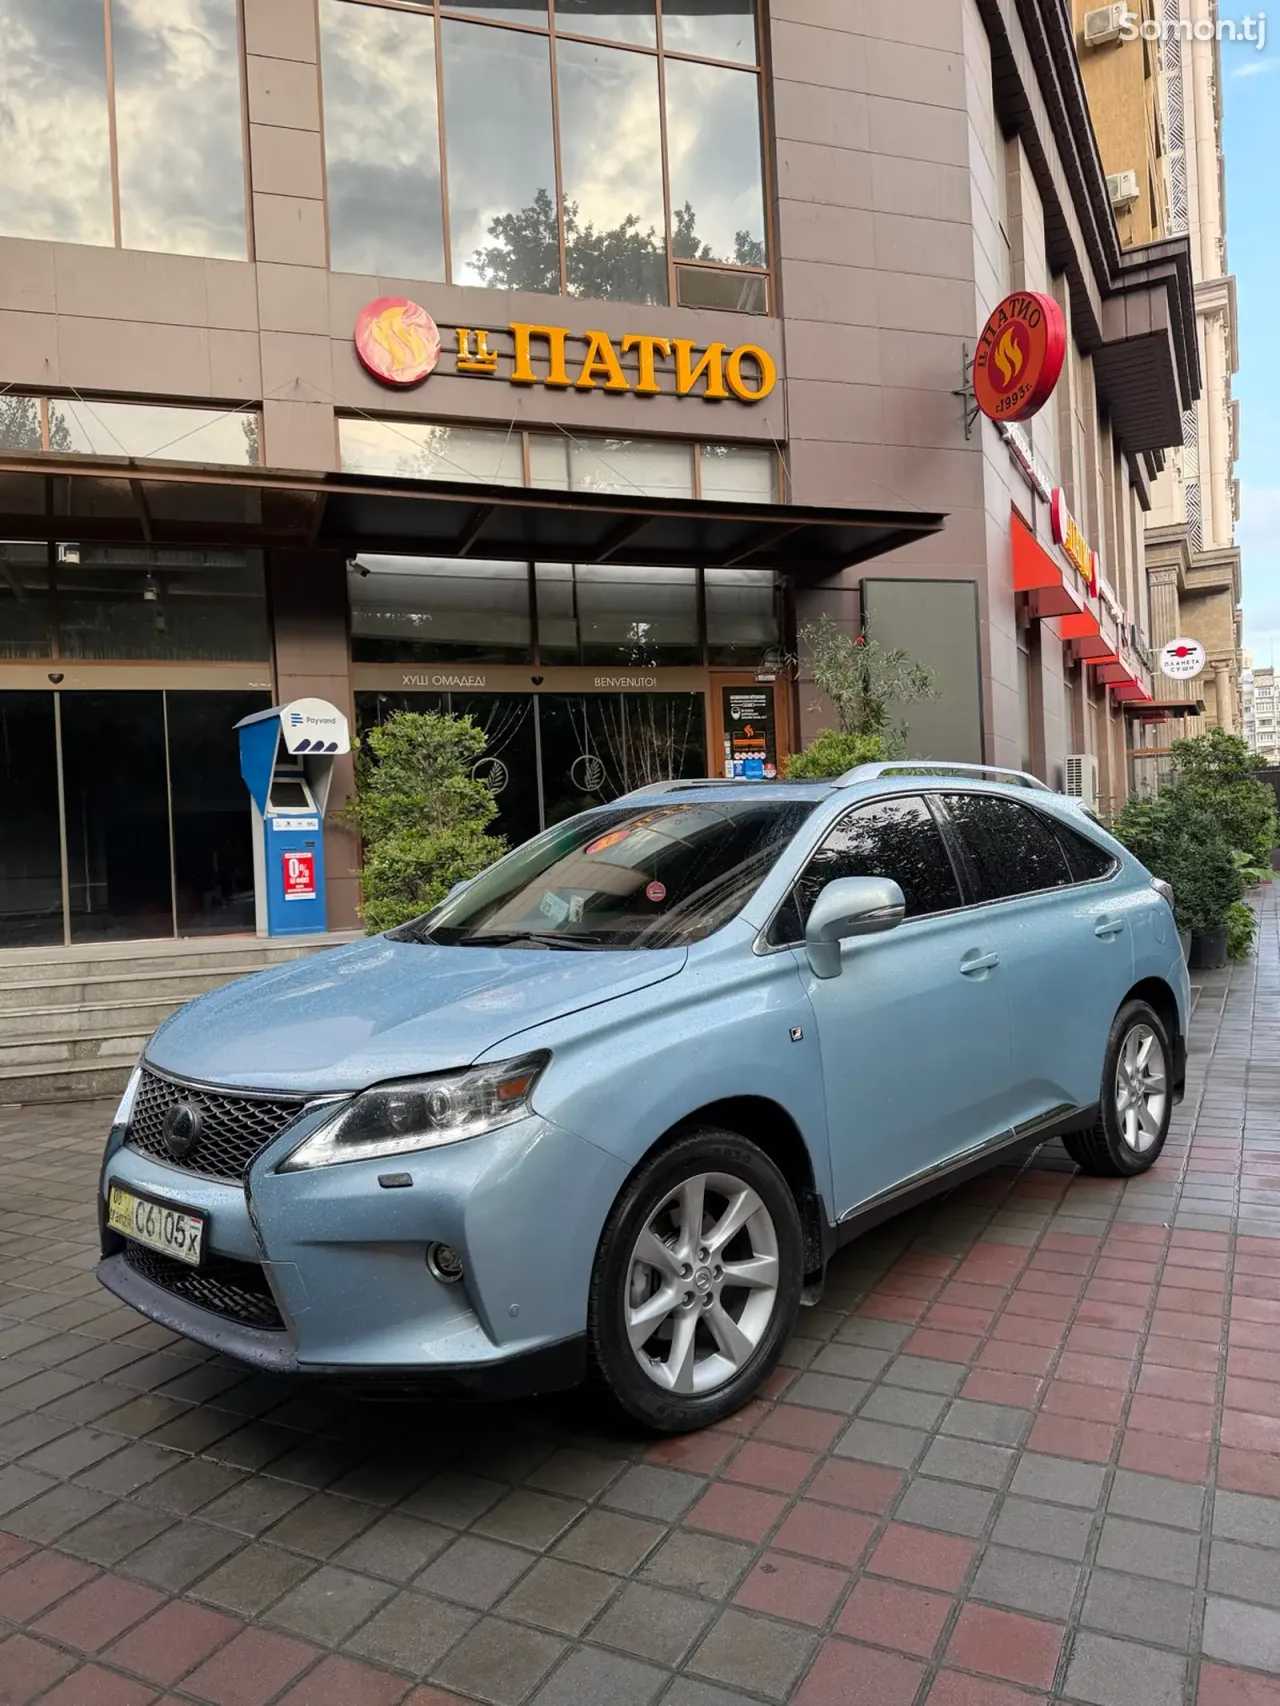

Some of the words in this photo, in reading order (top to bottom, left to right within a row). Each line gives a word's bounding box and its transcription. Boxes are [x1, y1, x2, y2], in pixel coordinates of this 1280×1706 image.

[981, 297, 1042, 347] ПАТИО
[509, 322, 778, 402] ПАТИО
[1164, 659, 1200, 668] ПЛАНЕТА
[1170, 665, 1195, 673] СУШИ
[402, 675, 429, 686] ХУШ
[594, 677, 657, 687] BENVENUTO!
[306, 716, 336, 725] Payvand
